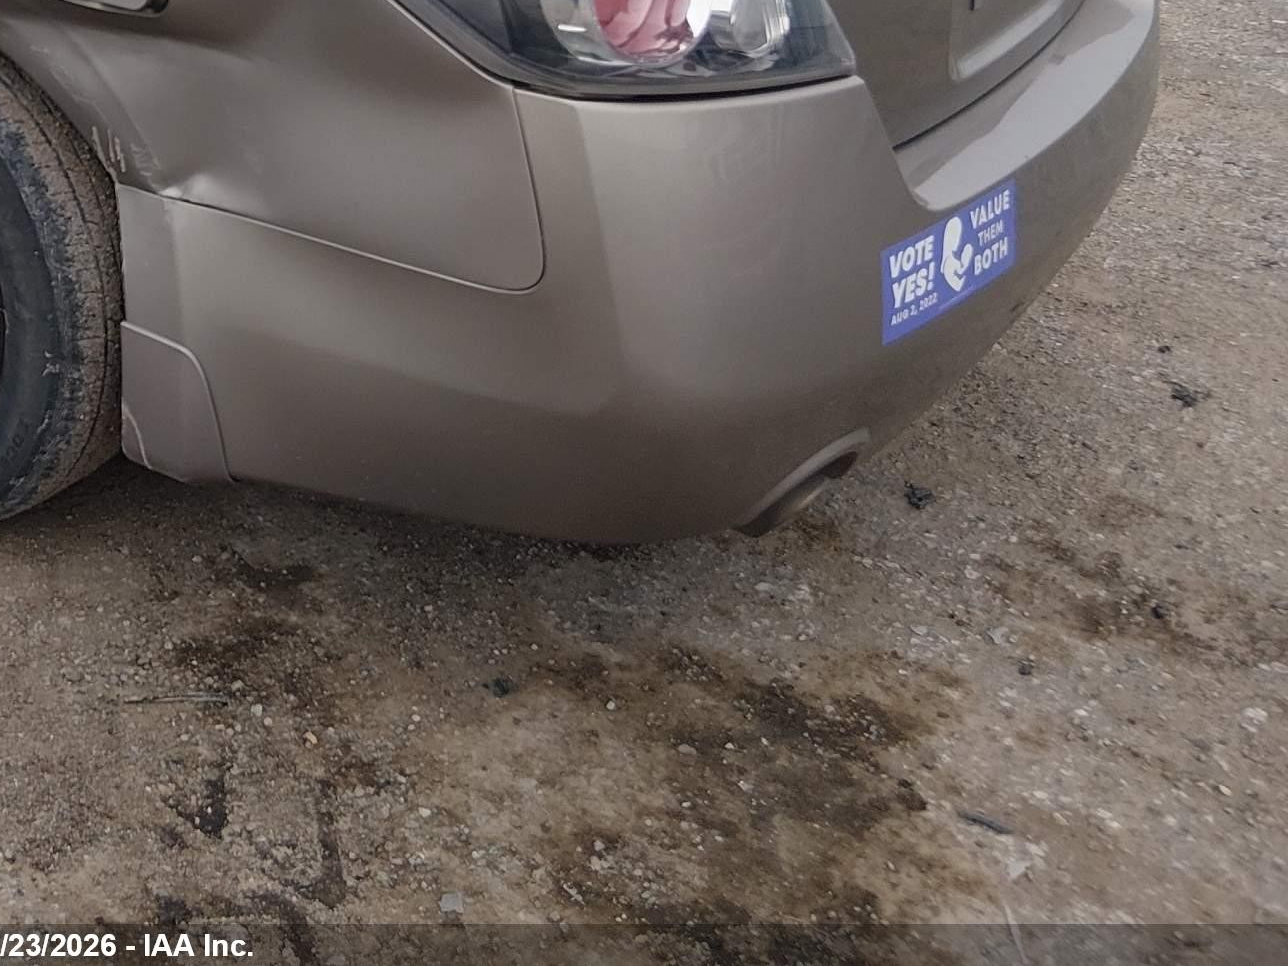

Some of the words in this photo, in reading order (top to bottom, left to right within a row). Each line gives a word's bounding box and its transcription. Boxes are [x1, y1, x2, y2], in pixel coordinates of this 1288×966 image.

[970, 190, 1011, 229] VALUE
[978, 220, 1006, 247] THEM
[890, 235, 935, 278] VOTE
[974, 237, 1010, 275] BOTH
[893, 262, 936, 308] YES!
[891, 312, 910, 326] AUG
